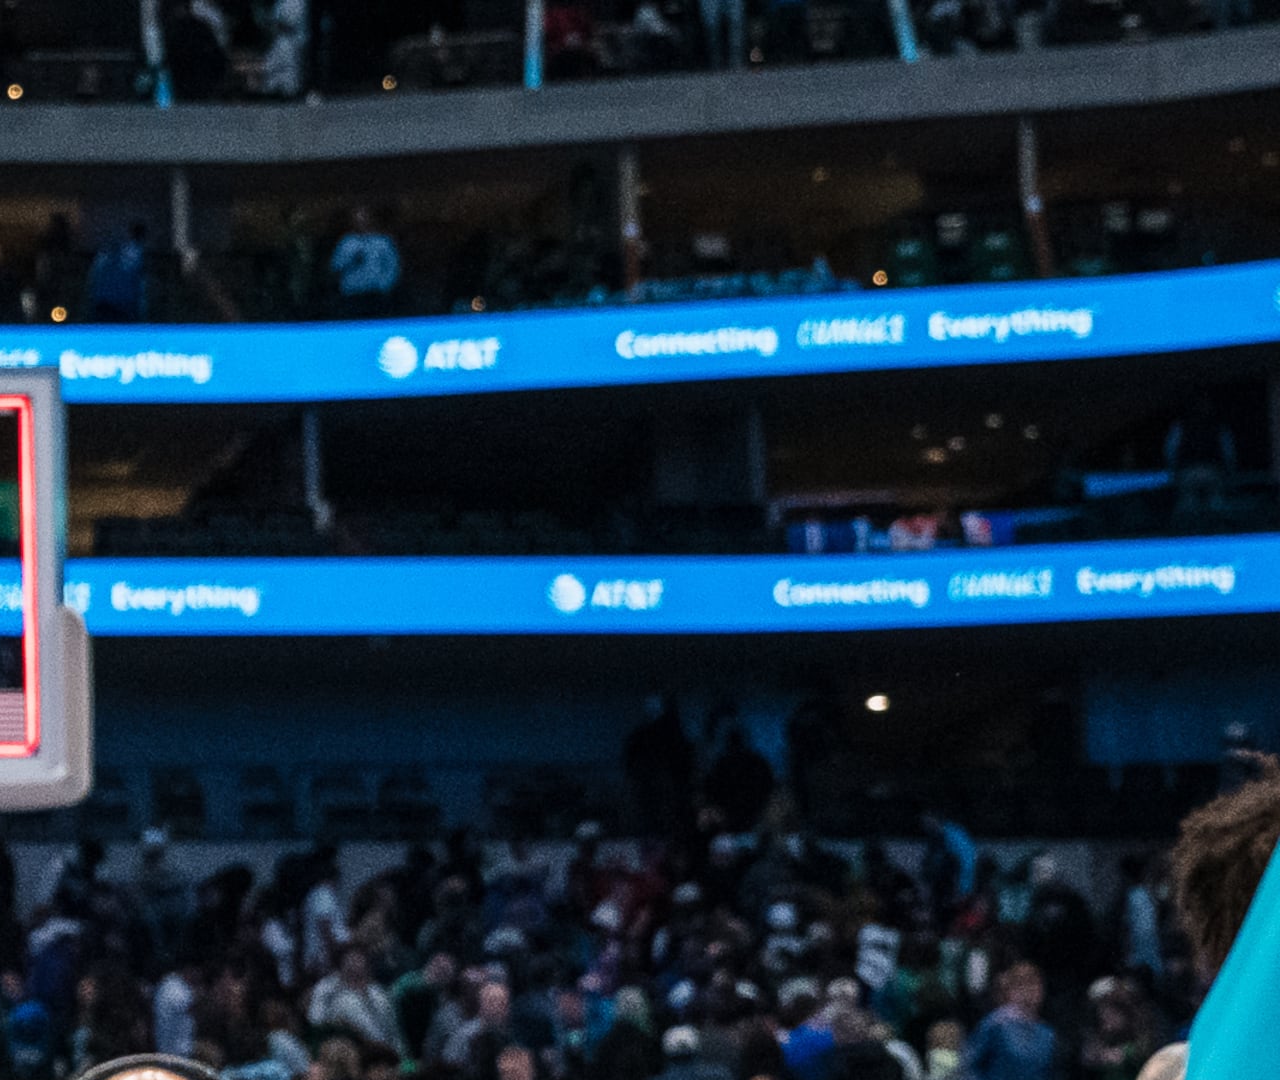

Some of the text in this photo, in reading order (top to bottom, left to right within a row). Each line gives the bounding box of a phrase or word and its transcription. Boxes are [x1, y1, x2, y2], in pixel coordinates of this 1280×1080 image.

[615, 327, 779, 359] Connecting
[928, 308, 1094, 341] Everything
[59, 350, 213, 384] Everything
[423, 336, 501, 371] AT&T
[111, 582, 261, 617] Everything
[590, 578, 664, 611] AT&T
[773, 578, 930, 608] Connecting
[1076, 564, 1236, 596] Everything
